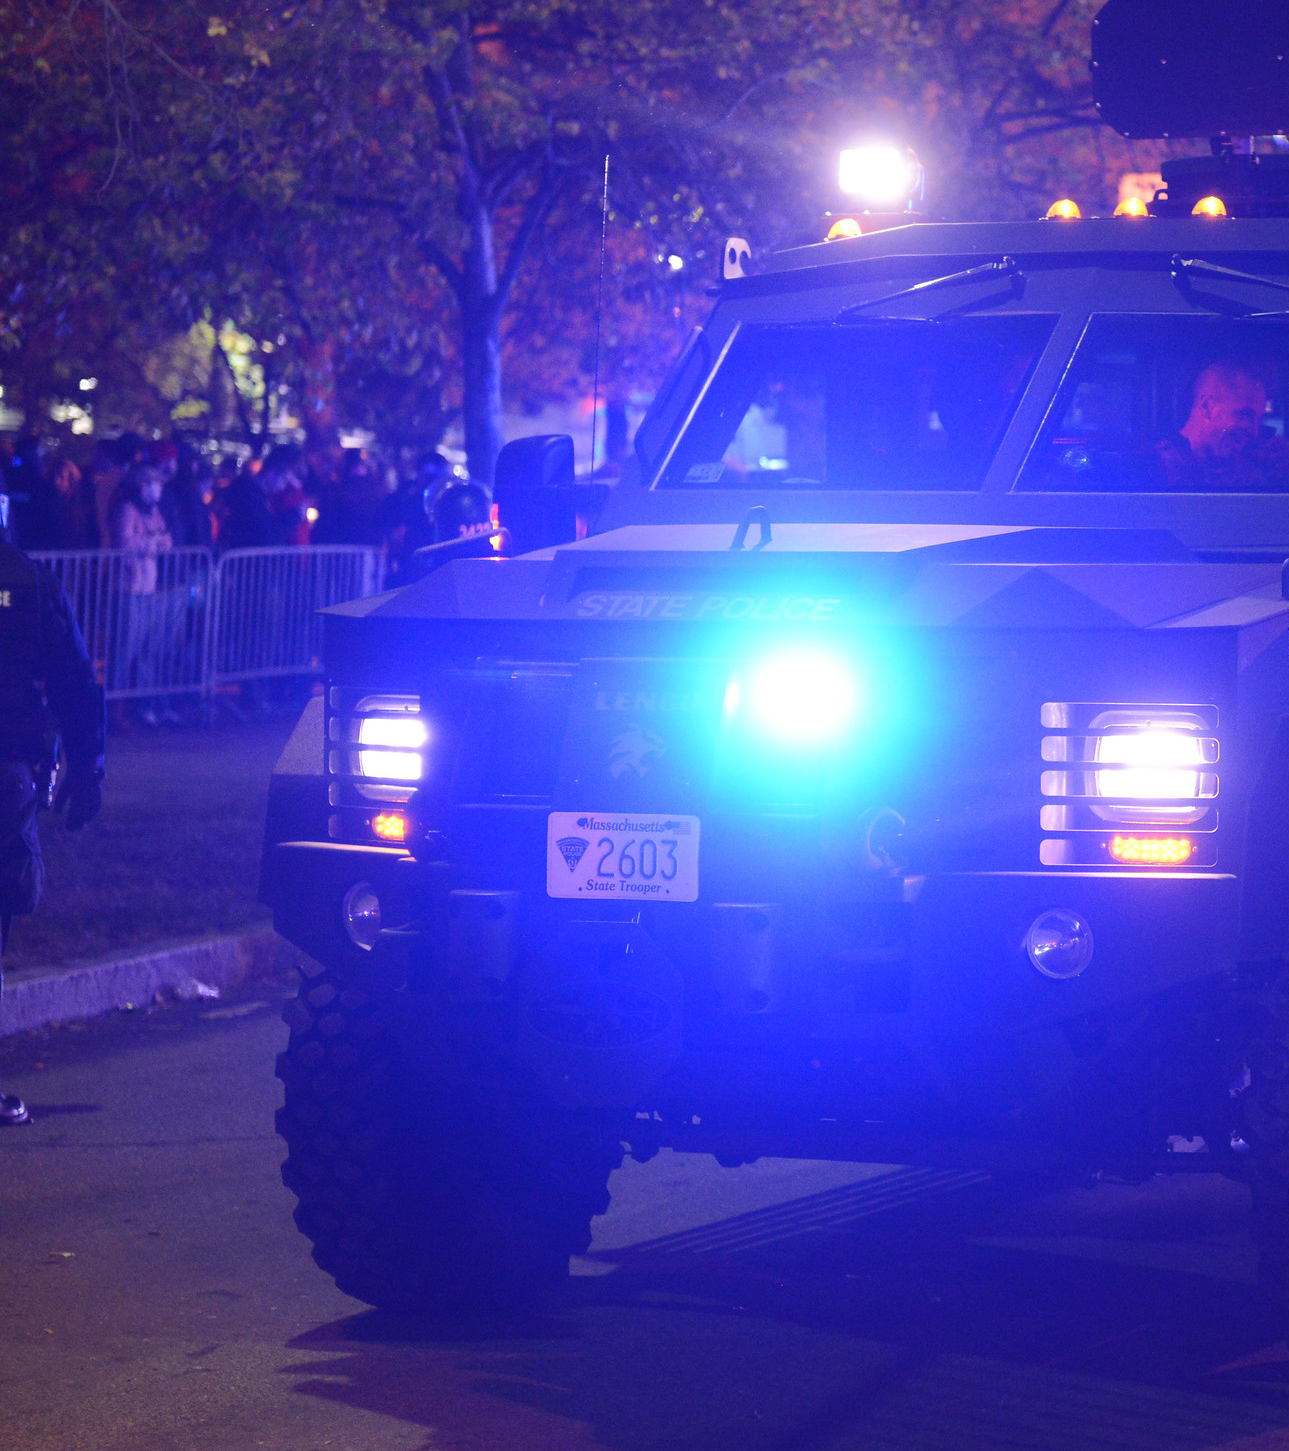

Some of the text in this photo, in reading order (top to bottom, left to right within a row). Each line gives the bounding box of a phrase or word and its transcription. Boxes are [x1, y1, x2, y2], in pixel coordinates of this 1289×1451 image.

[577, 594, 841, 620] STATE POLICE
[583, 817, 665, 833] Massachusetts
[597, 837, 679, 880] 2603
[586, 879, 662, 895] State Trooper
